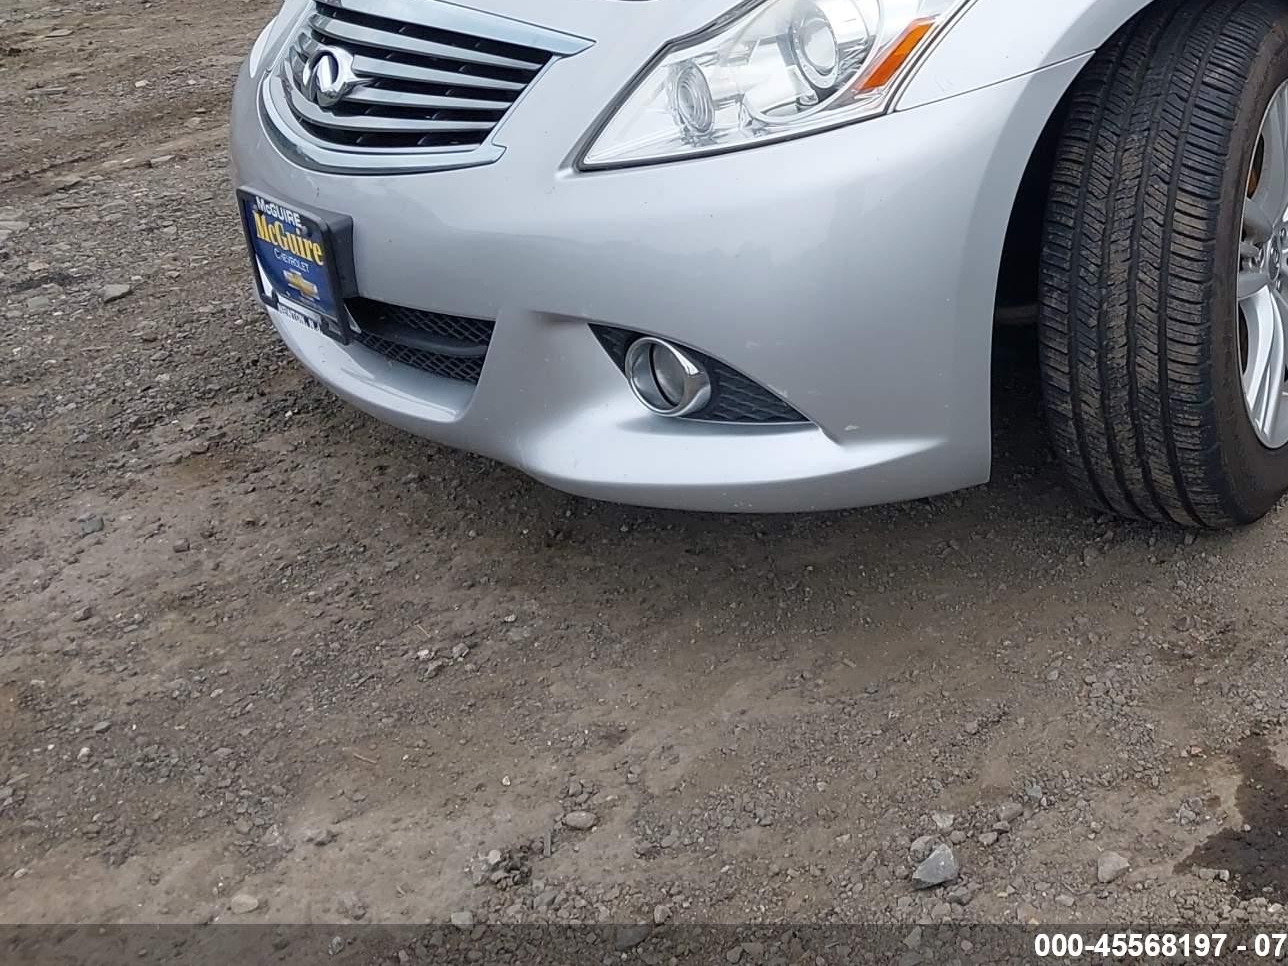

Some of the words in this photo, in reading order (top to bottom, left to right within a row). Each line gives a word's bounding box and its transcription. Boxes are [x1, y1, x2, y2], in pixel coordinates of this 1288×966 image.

[255, 196, 303, 227] McGUIRE
[252, 209, 324, 266] McGuire
[274, 247, 310, 273] CHEVROLET
